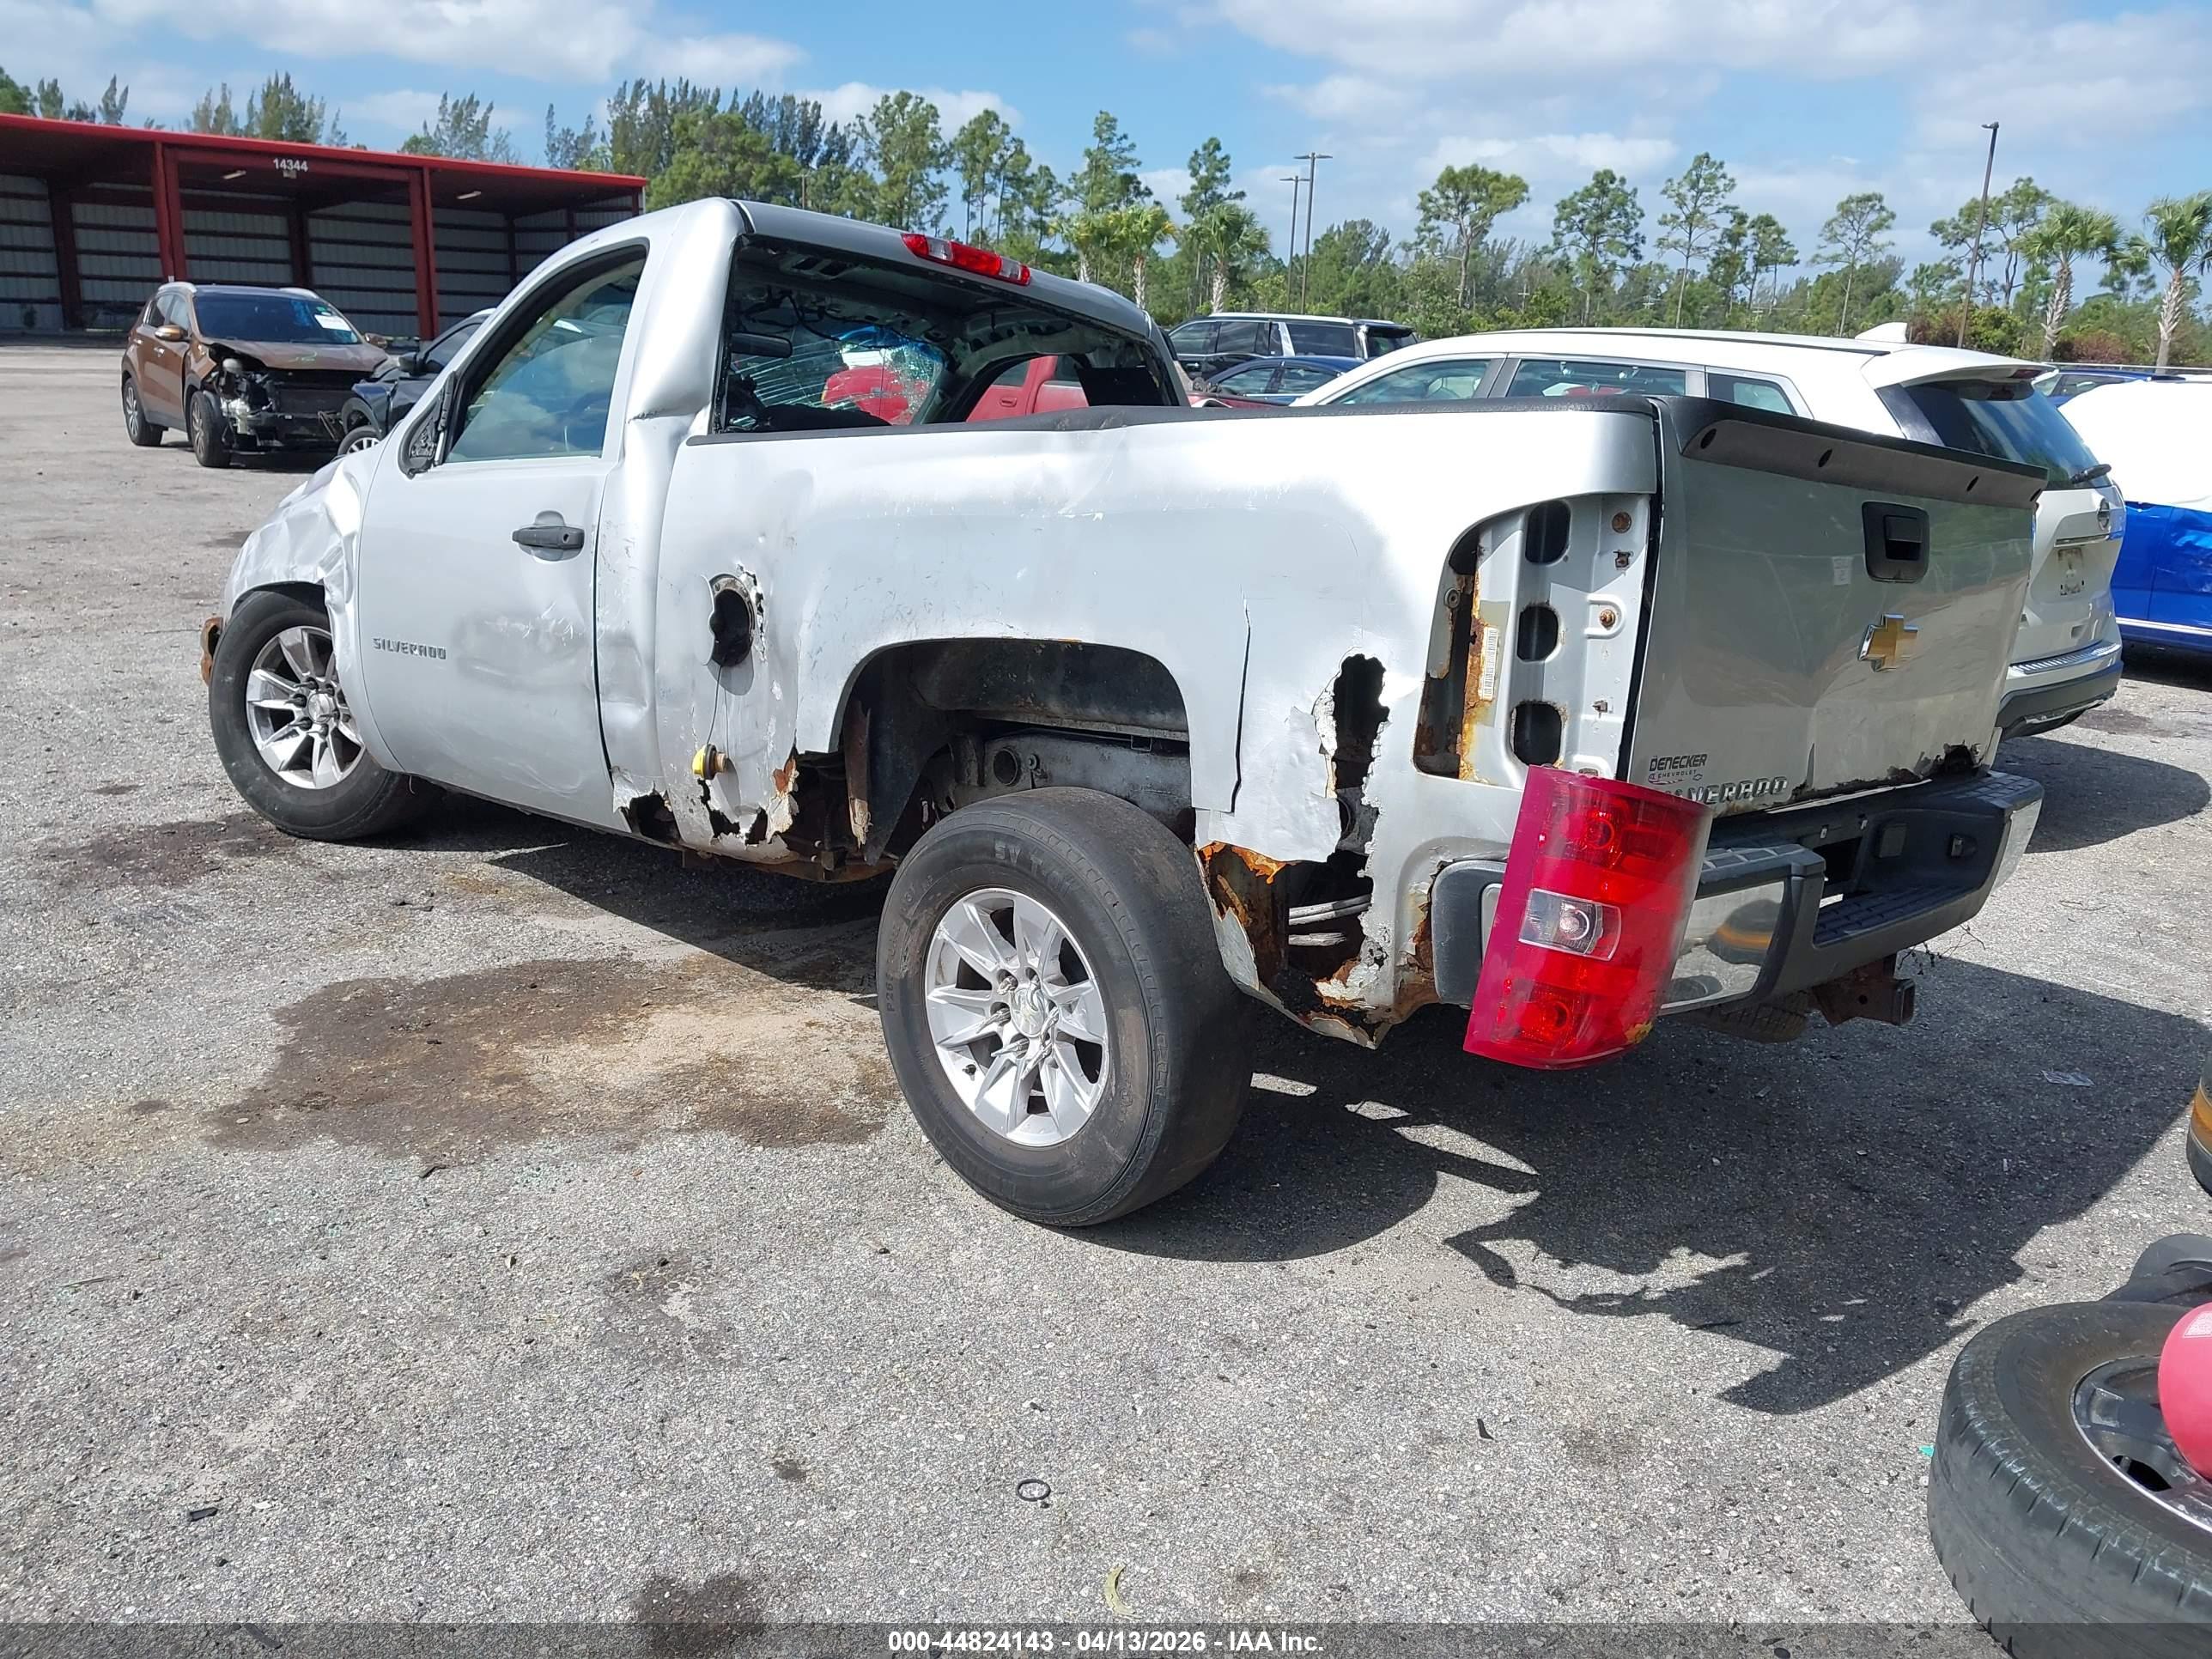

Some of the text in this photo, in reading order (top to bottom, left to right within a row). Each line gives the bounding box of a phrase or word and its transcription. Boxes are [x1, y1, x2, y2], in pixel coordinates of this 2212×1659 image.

[273, 158, 309, 172] 14344
[373, 637, 447, 659] SILVERADO
[1649, 754, 1707, 772] DENECKER
[1657, 769, 1697, 778] CHEVROLET
